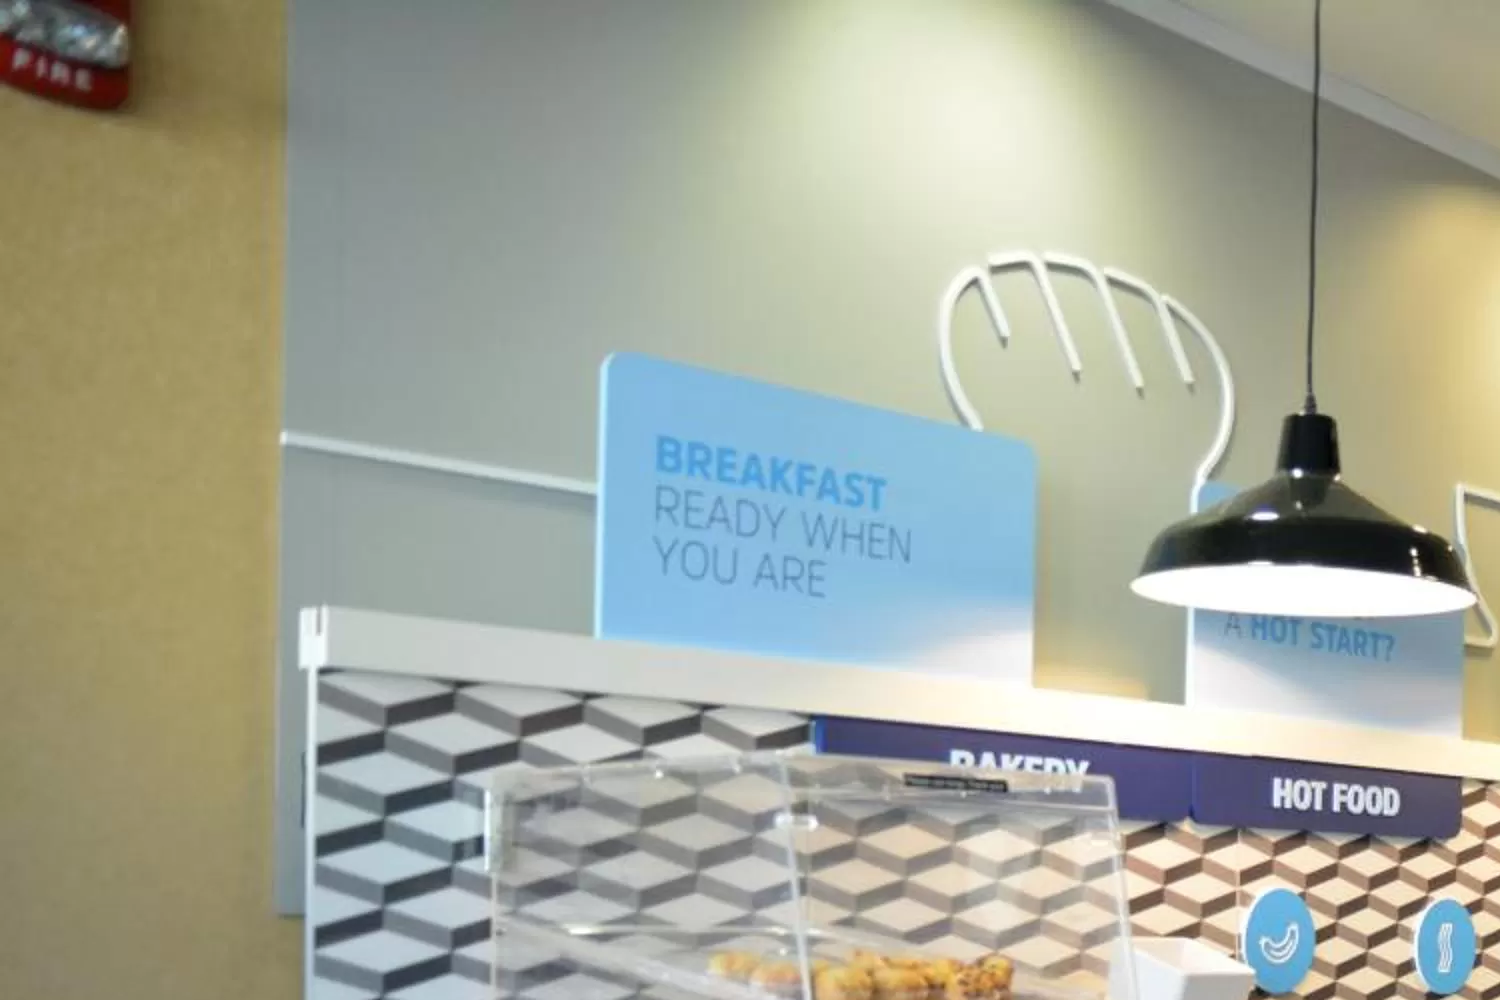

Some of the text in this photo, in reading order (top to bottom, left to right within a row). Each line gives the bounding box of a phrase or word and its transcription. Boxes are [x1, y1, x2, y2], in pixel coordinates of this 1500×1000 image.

[12, 47, 93, 92] FIRE
[656, 434, 888, 512] BREAKFAST
[655, 484, 912, 564] READY WHEN
[652, 535, 828, 598] YOU ARE
[1223, 612, 1396, 663] A HOT START?
[1273, 776, 1401, 817] HOT FOOD
